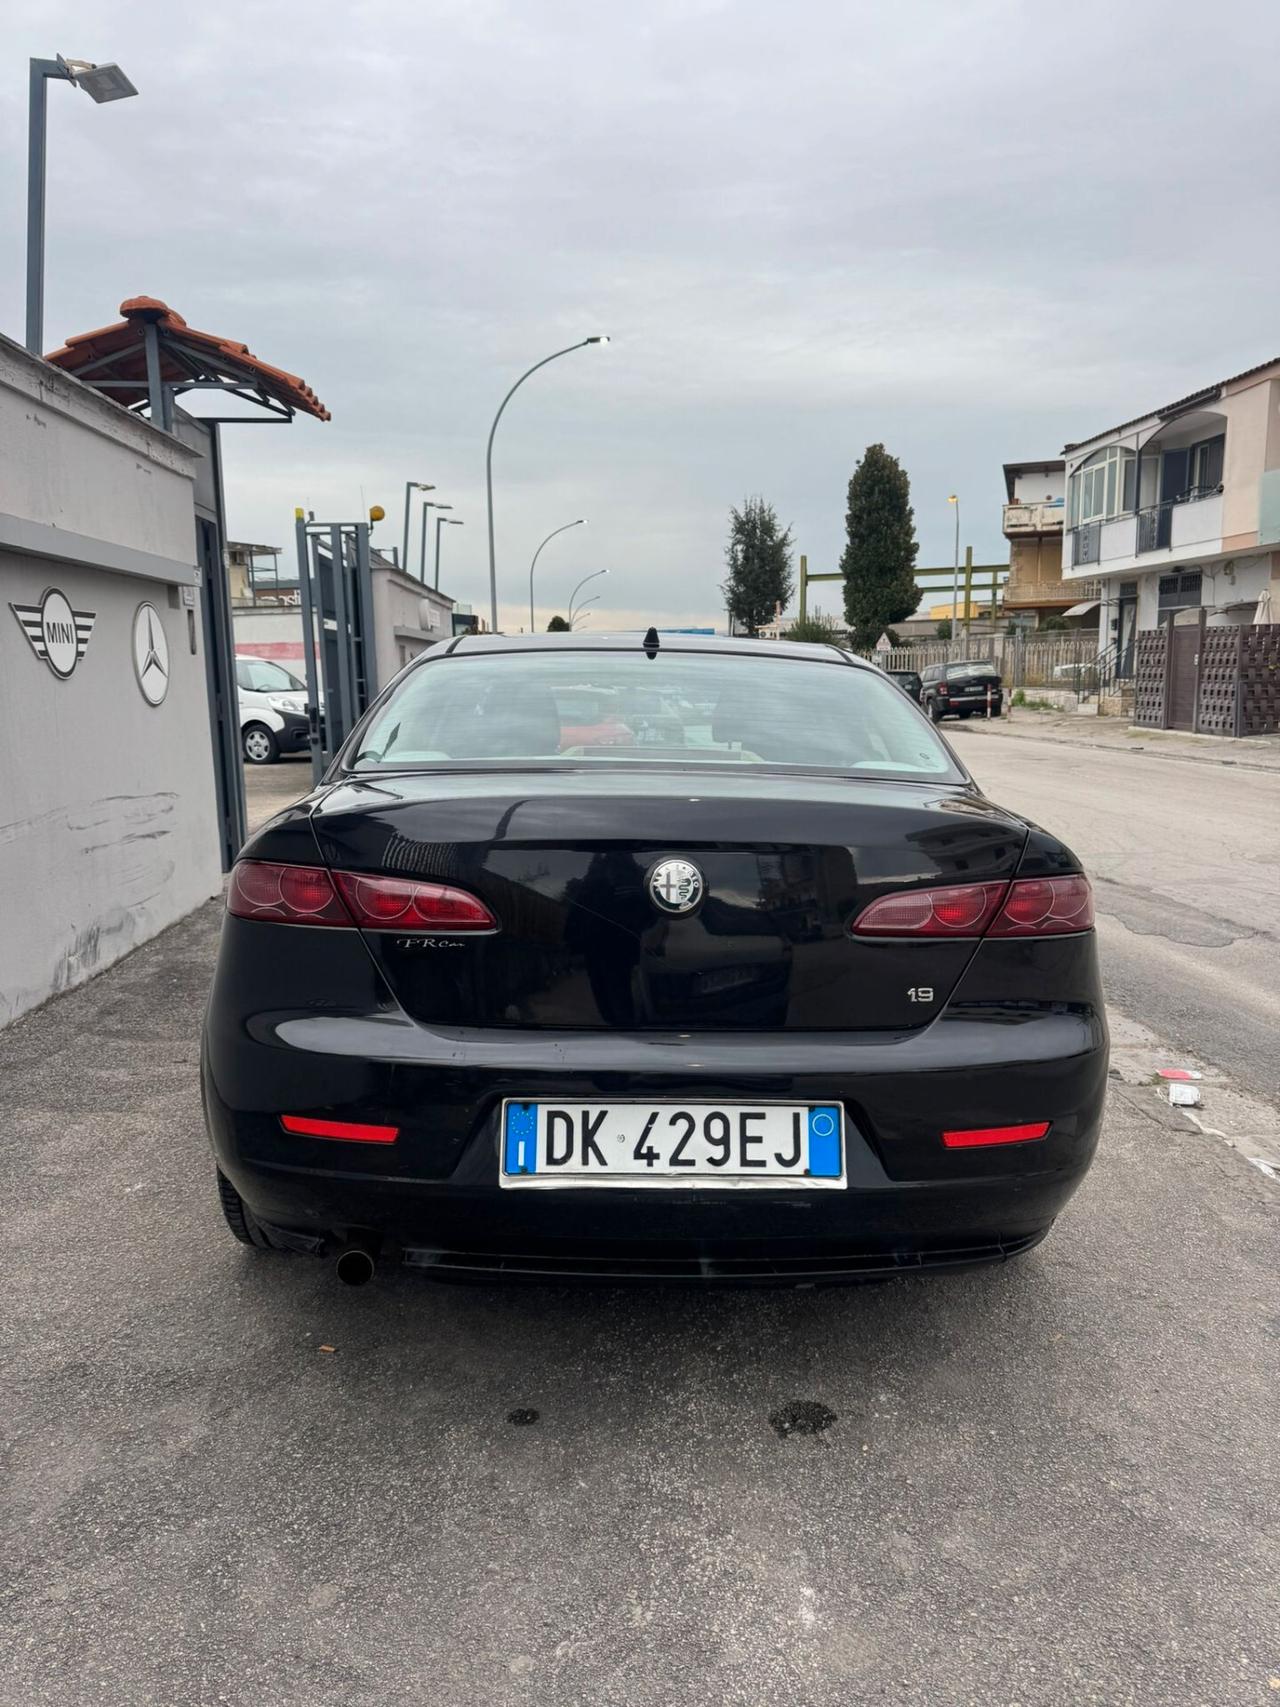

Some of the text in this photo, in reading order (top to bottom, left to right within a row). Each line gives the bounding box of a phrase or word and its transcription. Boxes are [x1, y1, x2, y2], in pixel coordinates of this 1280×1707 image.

[46, 622, 74, 644] MINI
[545, 1110, 801, 1168] DK 429EJ
